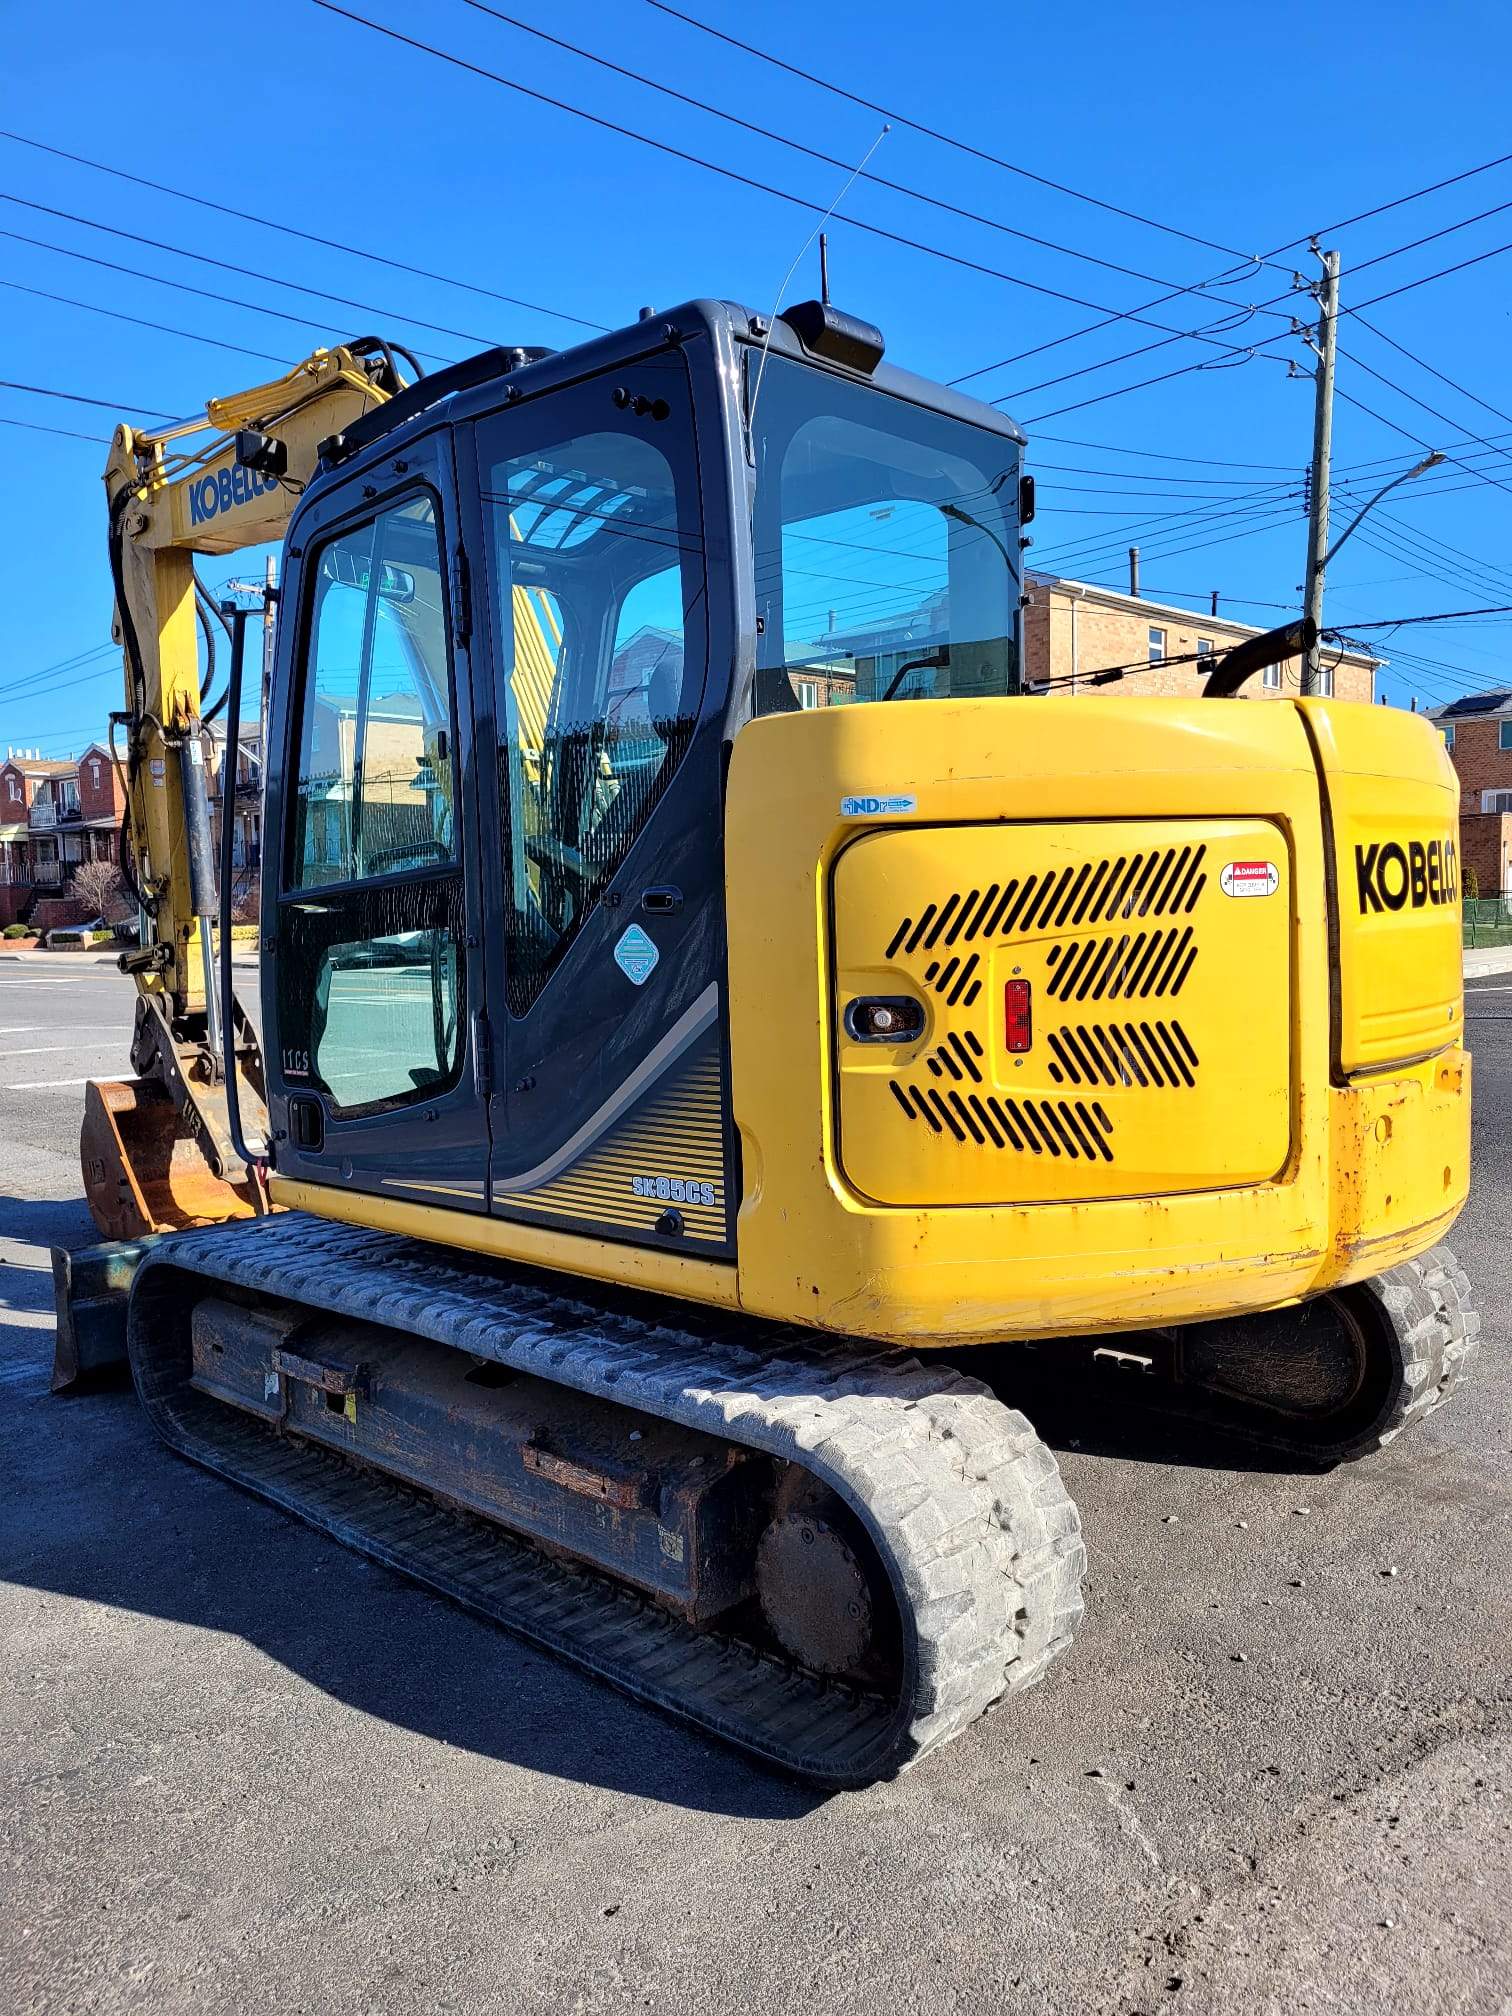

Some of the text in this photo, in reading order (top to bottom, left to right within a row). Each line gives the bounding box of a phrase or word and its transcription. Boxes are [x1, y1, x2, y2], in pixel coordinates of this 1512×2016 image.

[1241, 867, 1267, 876] DANGER
[283, 1049, 309, 1070] ITCS
[632, 1176, 715, 1206] SK85CS
